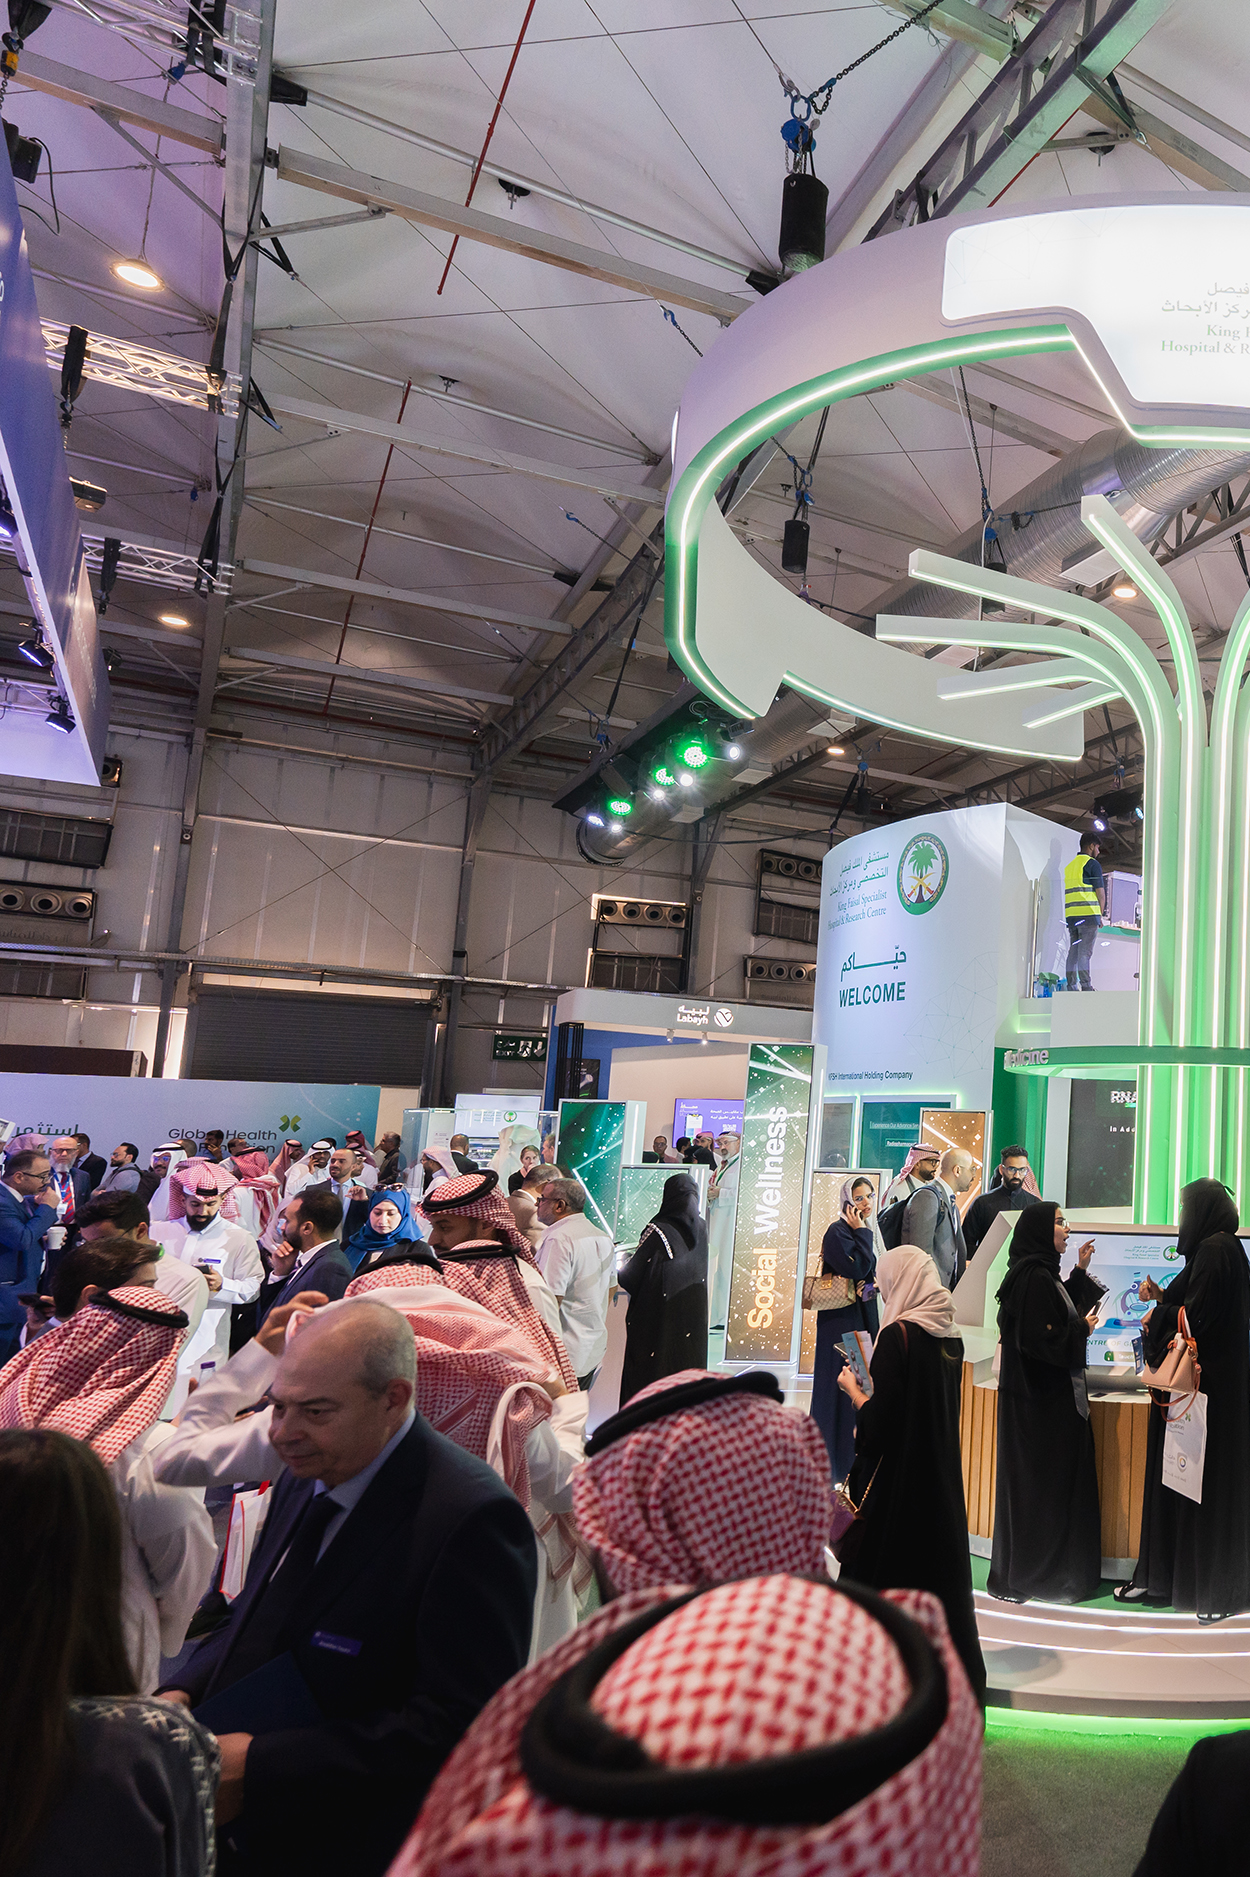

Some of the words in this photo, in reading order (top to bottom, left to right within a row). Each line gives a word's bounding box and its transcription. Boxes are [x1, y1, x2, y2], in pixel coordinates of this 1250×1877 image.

[1207, 282, 1250, 298] فيصل
[1161, 300, 1218, 318] الأبحاث
[1206, 324, 1240, 342] King
[1161, 340, 1220, 356] Hospital
[1223, 342, 1237, 354] &
[847, 894, 860, 909] Faisal
[861, 889, 887, 907] Specialist
[845, 908, 866, 924] Research
[866, 906, 887, 918] Centre
[839, 981, 906, 1008] WELCOME
[677, 1013, 709, 1026] Labayh
[838, 1072, 864, 1080] International
[864, 1070, 883, 1081] Holding
[884, 1070, 914, 1081] Company
[168, 1128, 206, 1139] Glob
[226, 1129, 277, 1140] Health
[753, 1106, 788, 1235] Wellness
[747, 1248, 778, 1329] Social
